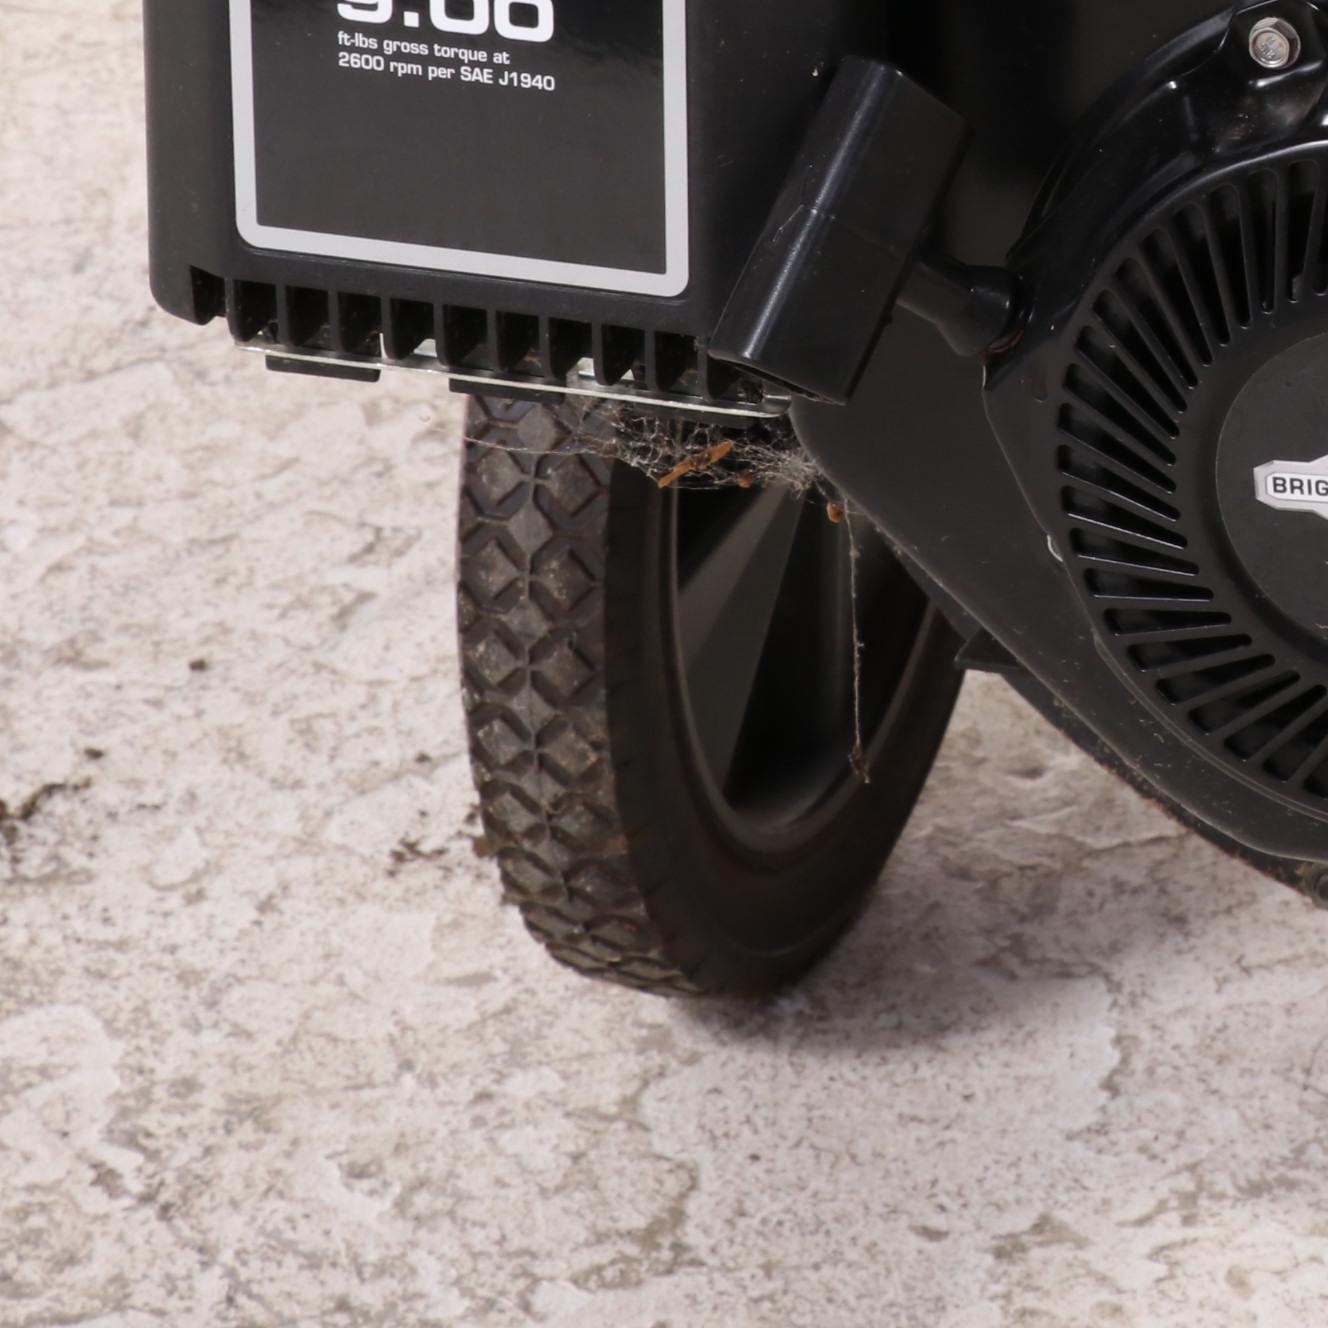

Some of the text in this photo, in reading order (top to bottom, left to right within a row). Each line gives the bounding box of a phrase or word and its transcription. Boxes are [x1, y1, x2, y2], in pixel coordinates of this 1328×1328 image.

[337, 30, 511, 65] ft-lbs gross torque at
[338, 51, 556, 92] 2600 rpm per SAE J1940
